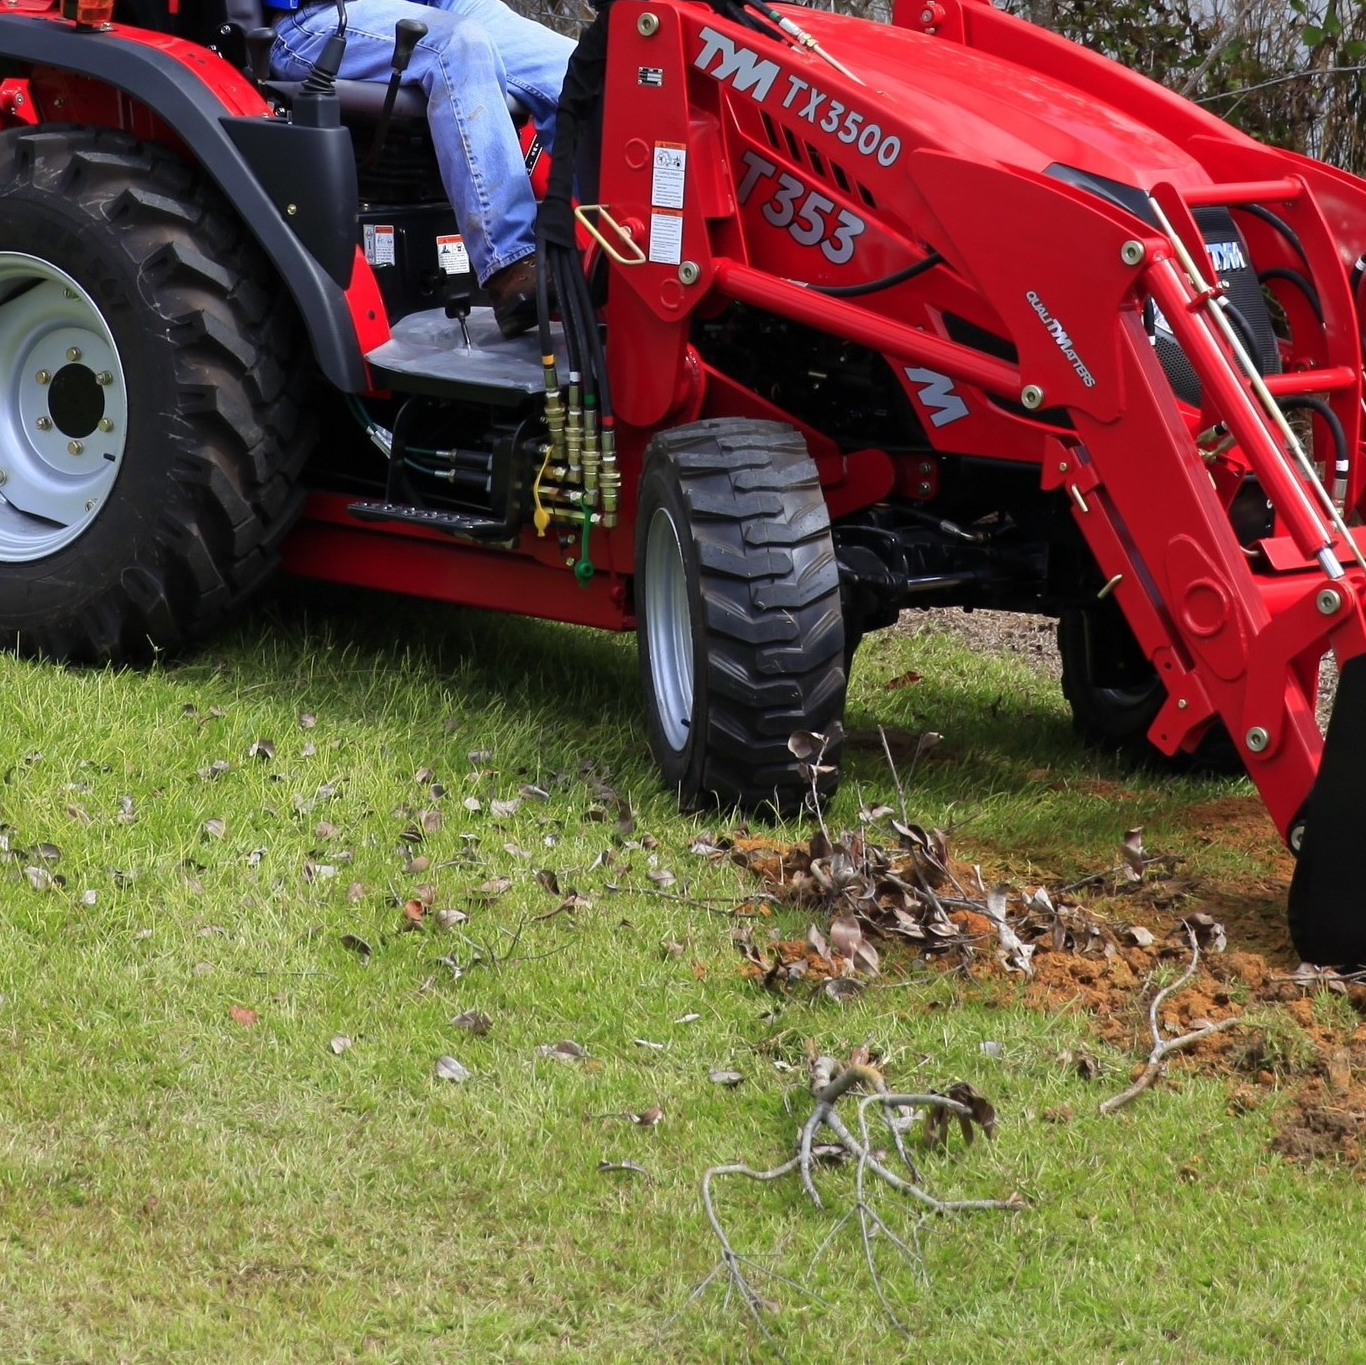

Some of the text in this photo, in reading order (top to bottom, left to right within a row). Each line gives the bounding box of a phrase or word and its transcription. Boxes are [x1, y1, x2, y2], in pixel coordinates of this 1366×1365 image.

[694, 26, 902, 167] TYM TX3500
[736, 150, 865, 265] T353
[1206, 241, 1248, 272] TYM
[1025, 290, 1096, 388] QUALITYMATTERS
